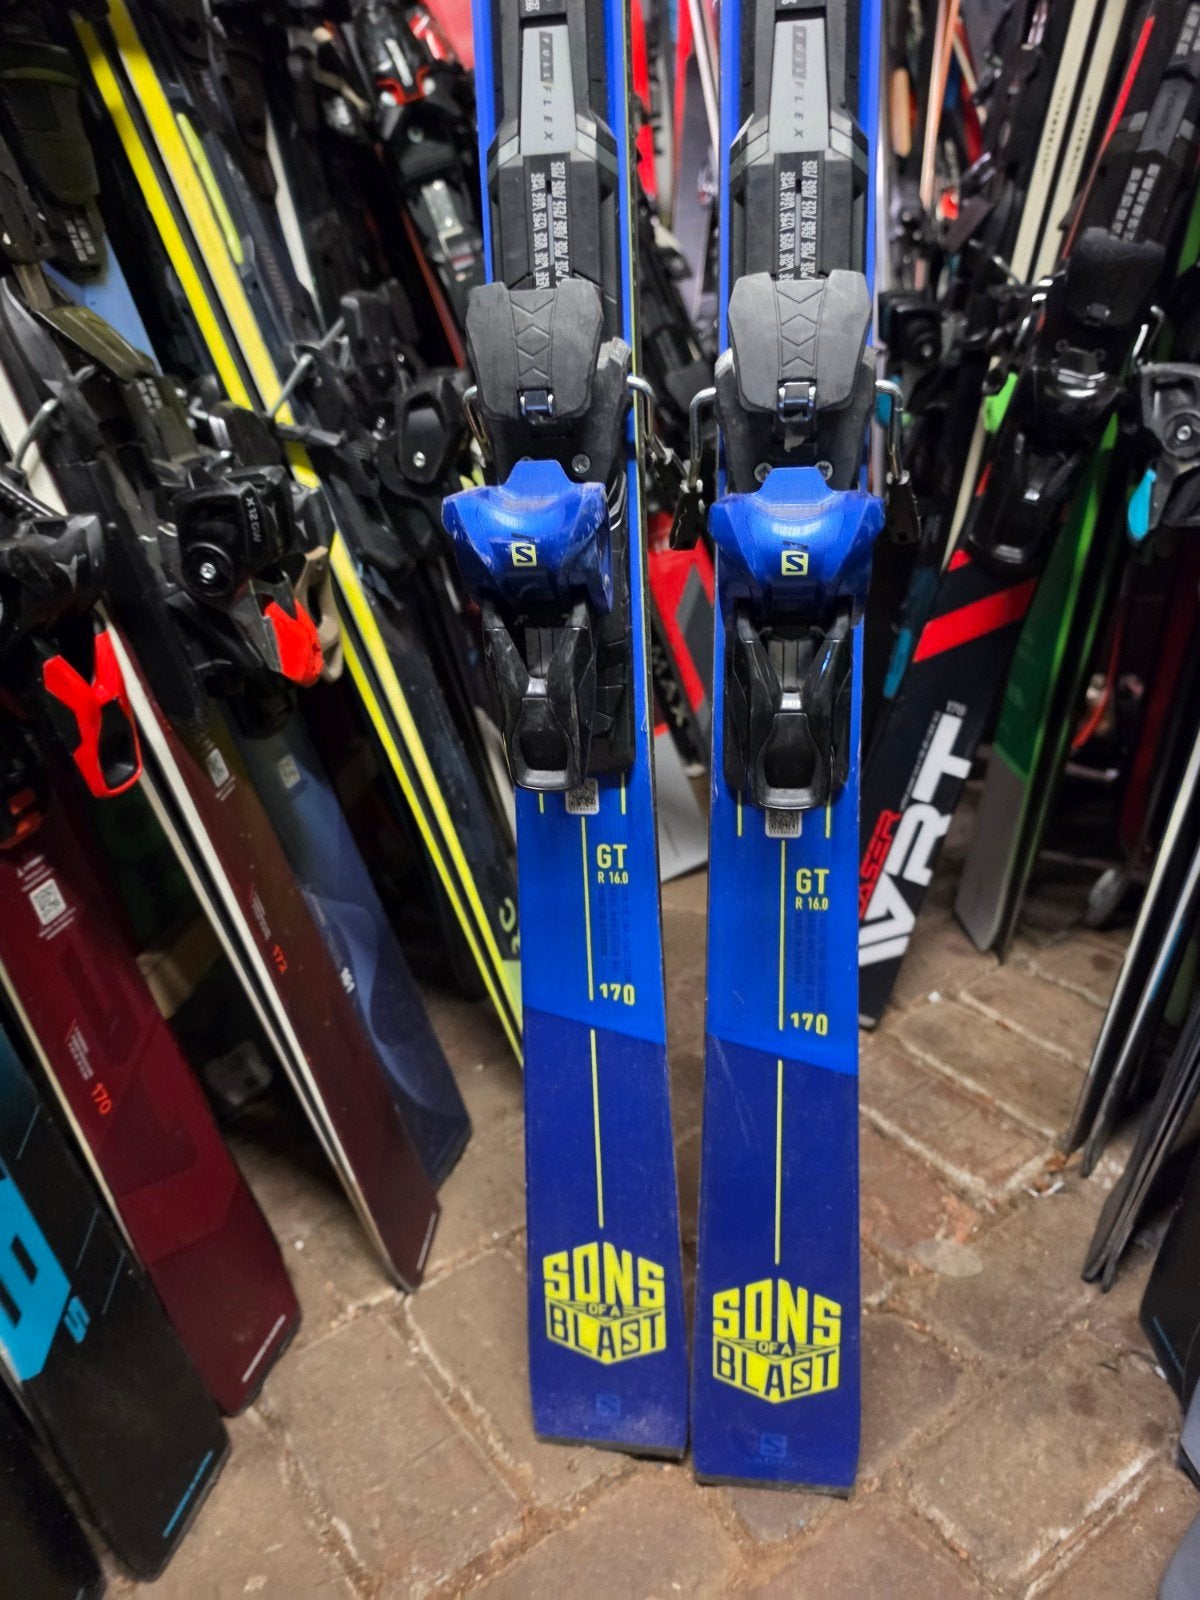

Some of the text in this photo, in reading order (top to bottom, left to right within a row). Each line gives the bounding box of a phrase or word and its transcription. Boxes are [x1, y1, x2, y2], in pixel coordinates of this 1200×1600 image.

[249, 507, 259, 521] 12
[596, 844, 628, 869] GT
[597, 871, 629, 885] R 16.0
[795, 868, 830, 895] GT
[795, 896, 829, 911] R 16.0
[599, 983, 636, 1006] 170
[790, 1012, 829, 1037] 170
[91, 1082, 113, 1116] 170
[543, 1241, 666, 1309] SONS
[587, 1303, 621, 1317] OF A
[712, 1278, 842, 1346] SONS
[548, 1302, 665, 1361] BLAST
[757, 1341, 793, 1356] OF A
[715, 1341, 837, 1400] BLAST
